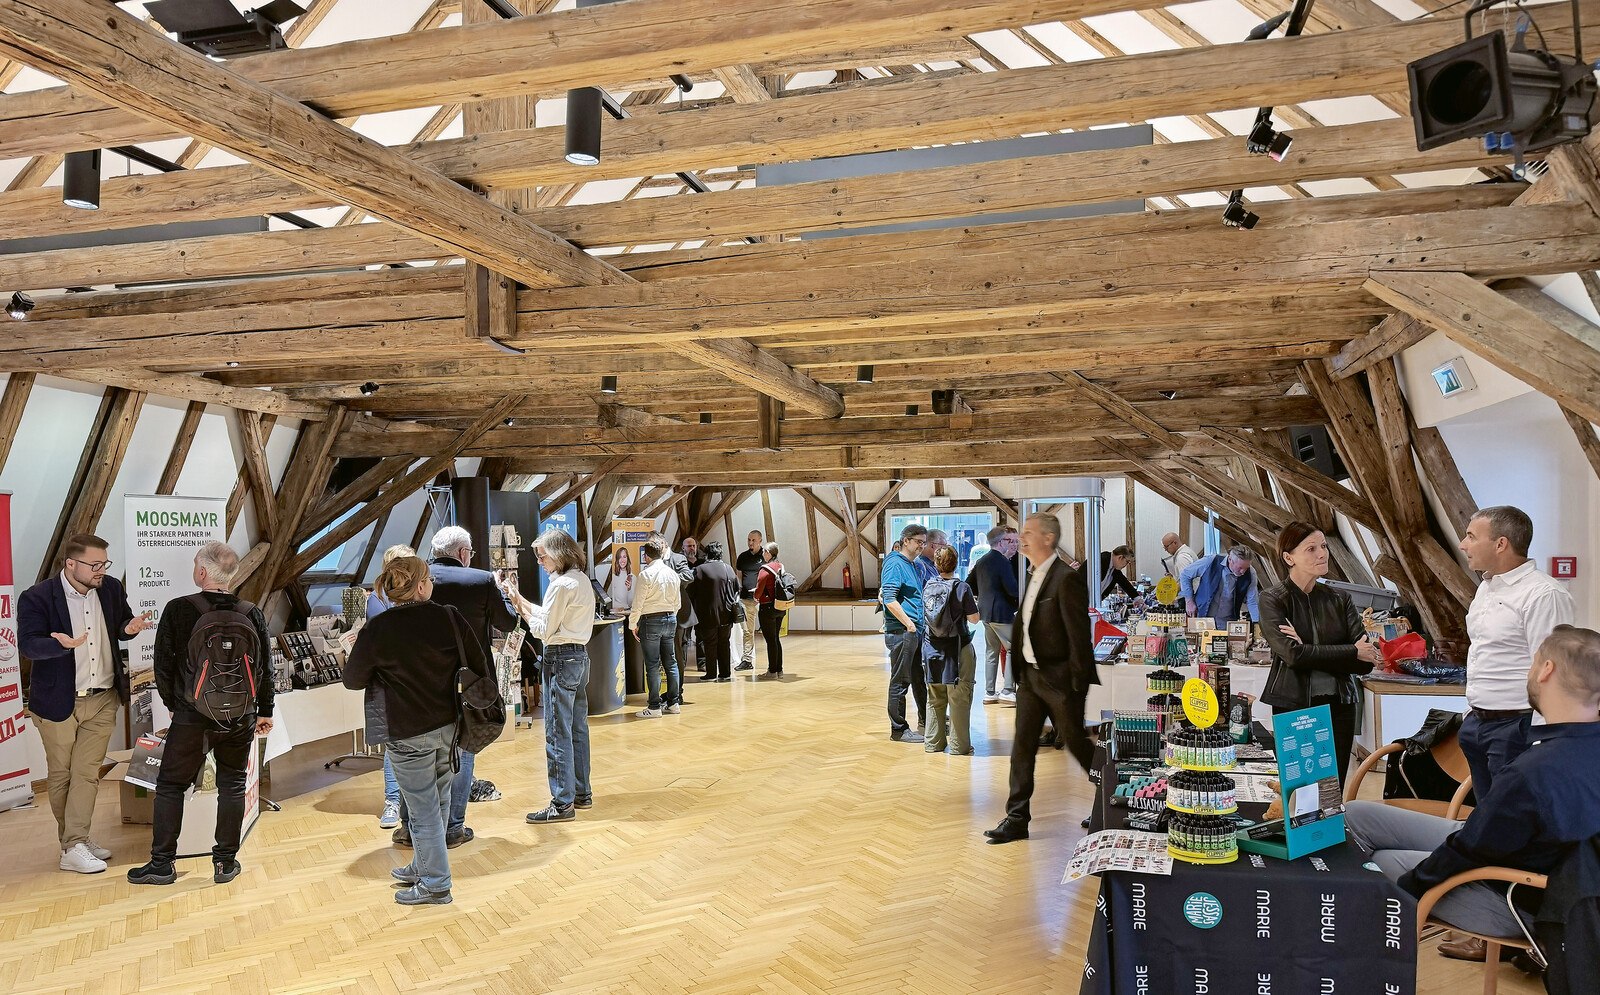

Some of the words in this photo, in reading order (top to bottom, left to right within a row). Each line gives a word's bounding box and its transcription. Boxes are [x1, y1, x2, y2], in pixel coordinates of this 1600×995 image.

[136, 511, 218, 527] MOOSMAYR
[137, 539, 196, 547] ÖSTERREICHISCHEN
[139, 567, 152, 578] 12
[139, 599, 157, 607] ÜBER
[1132, 883, 1146, 930] MARIE
[1256, 890, 1270, 938] MARIE
[1321, 894, 1335, 943] MARIE
[1386, 898, 1401, 949] MARIE
[1136, 965, 1148, 995] ARIE
